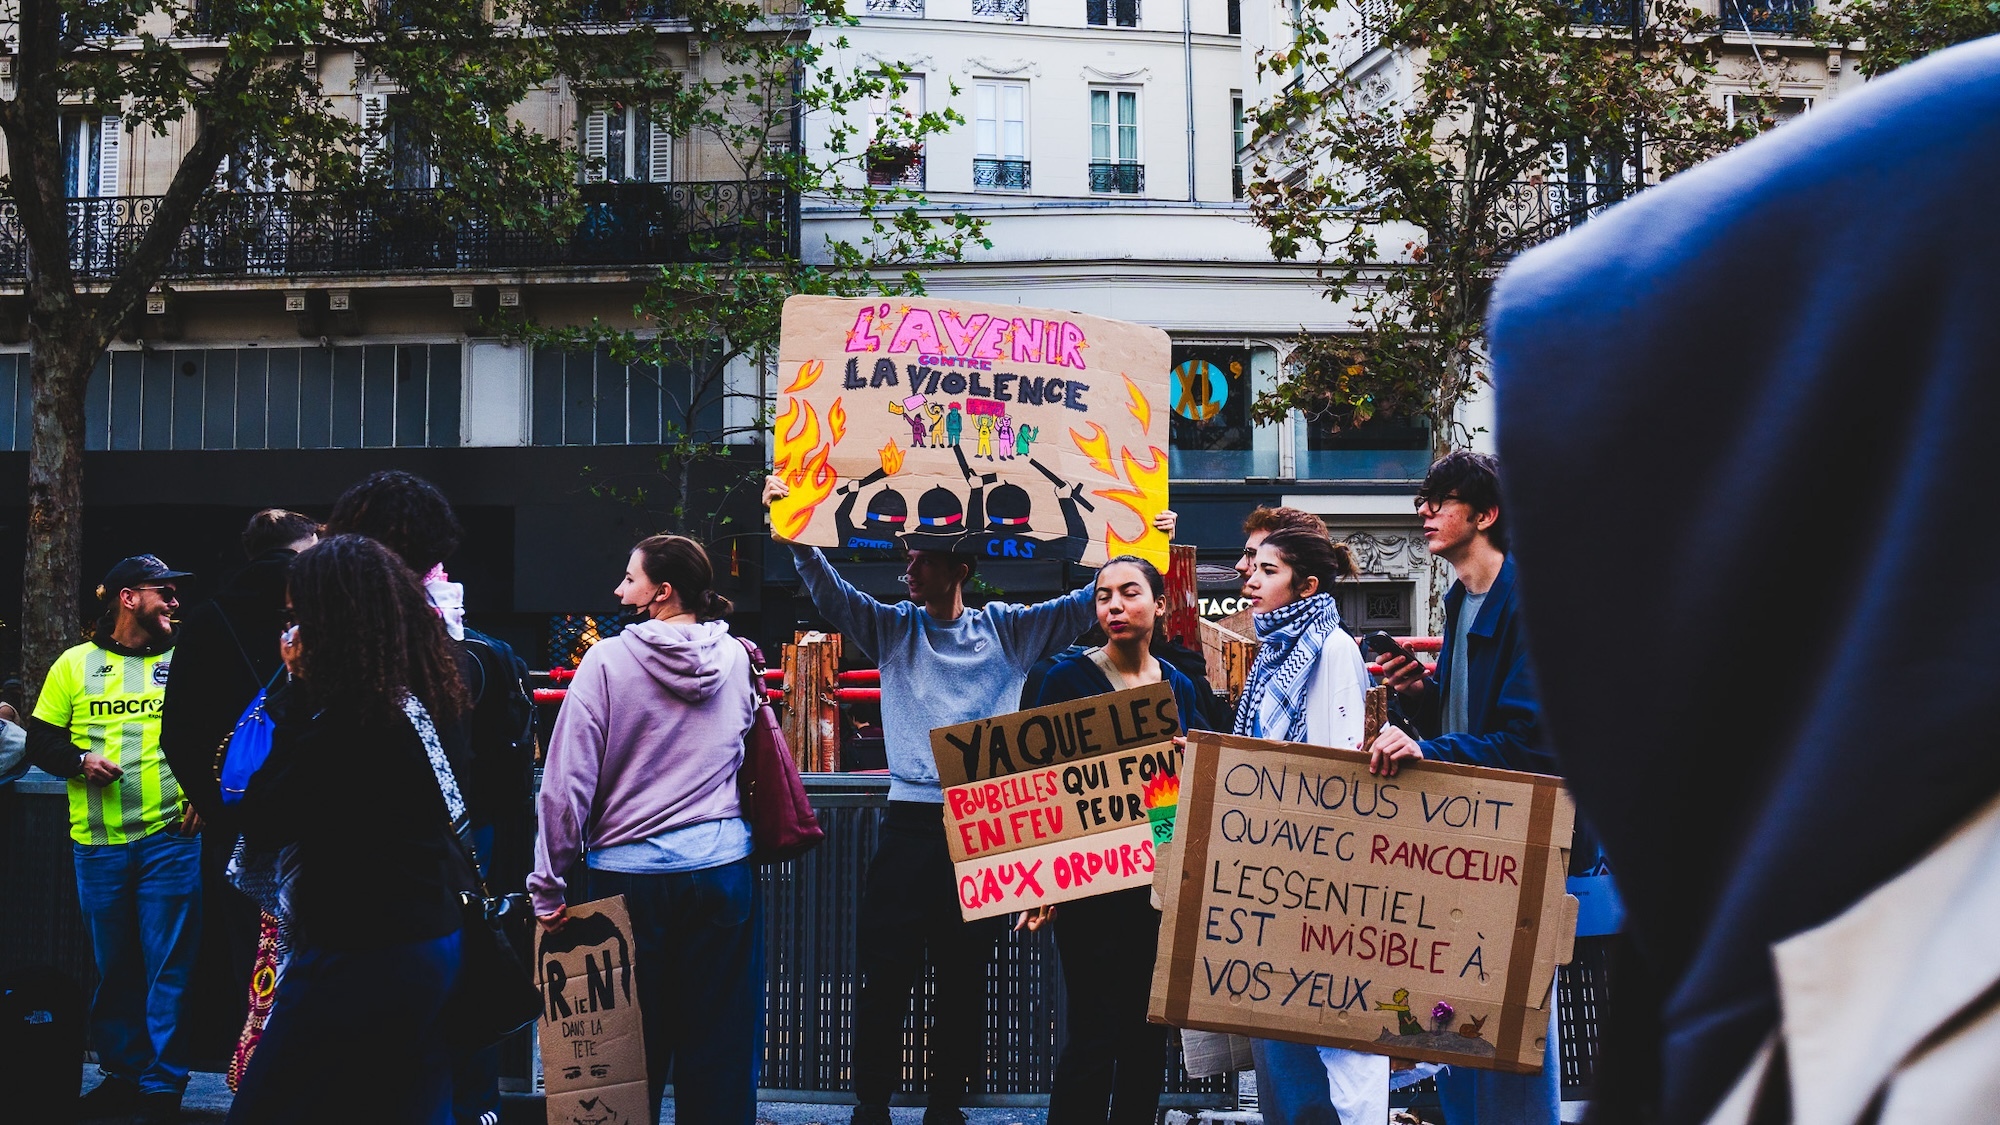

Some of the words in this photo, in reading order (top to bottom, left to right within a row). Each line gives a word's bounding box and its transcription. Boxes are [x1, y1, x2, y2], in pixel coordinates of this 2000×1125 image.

[845, 303, 1086, 370] L'AVENIR
[918, 355, 992, 371] CONTRE
[843, 356, 900, 390] LA
[907, 364, 1090, 413] VIOLENCE
[849, 538, 893, 550] POLICE
[986, 538, 1036, 558] CRS
[945, 719, 1016, 782] Y'A
[1017, 707, 1102, 765] QUE
[1108, 698, 1178, 746] LES
[947, 771, 1058, 821] POUBELLES
[1062, 760, 1109, 796] QUI
[1224, 763, 1287, 802] ON
[1297, 771, 1400, 819] NOUS
[958, 817, 1006, 856] EN
[1008, 805, 1064, 844] FEU
[1076, 793, 1146, 831] PEUR
[1154, 818, 1173, 838] RN
[1221, 809, 1354, 862] QU'AVEC
[959, 858, 1045, 909] Q'AUX
[1053, 840, 1156, 889] ORDURES
[1206, 906, 1276, 946] EST
[1459, 932, 1485, 980] À
[1203, 956, 1273, 1001] VOS
[1281, 967, 1371, 1011] YEUX
[562, 1021, 585, 1038] DANS
[590, 1019, 603, 1036] LA
